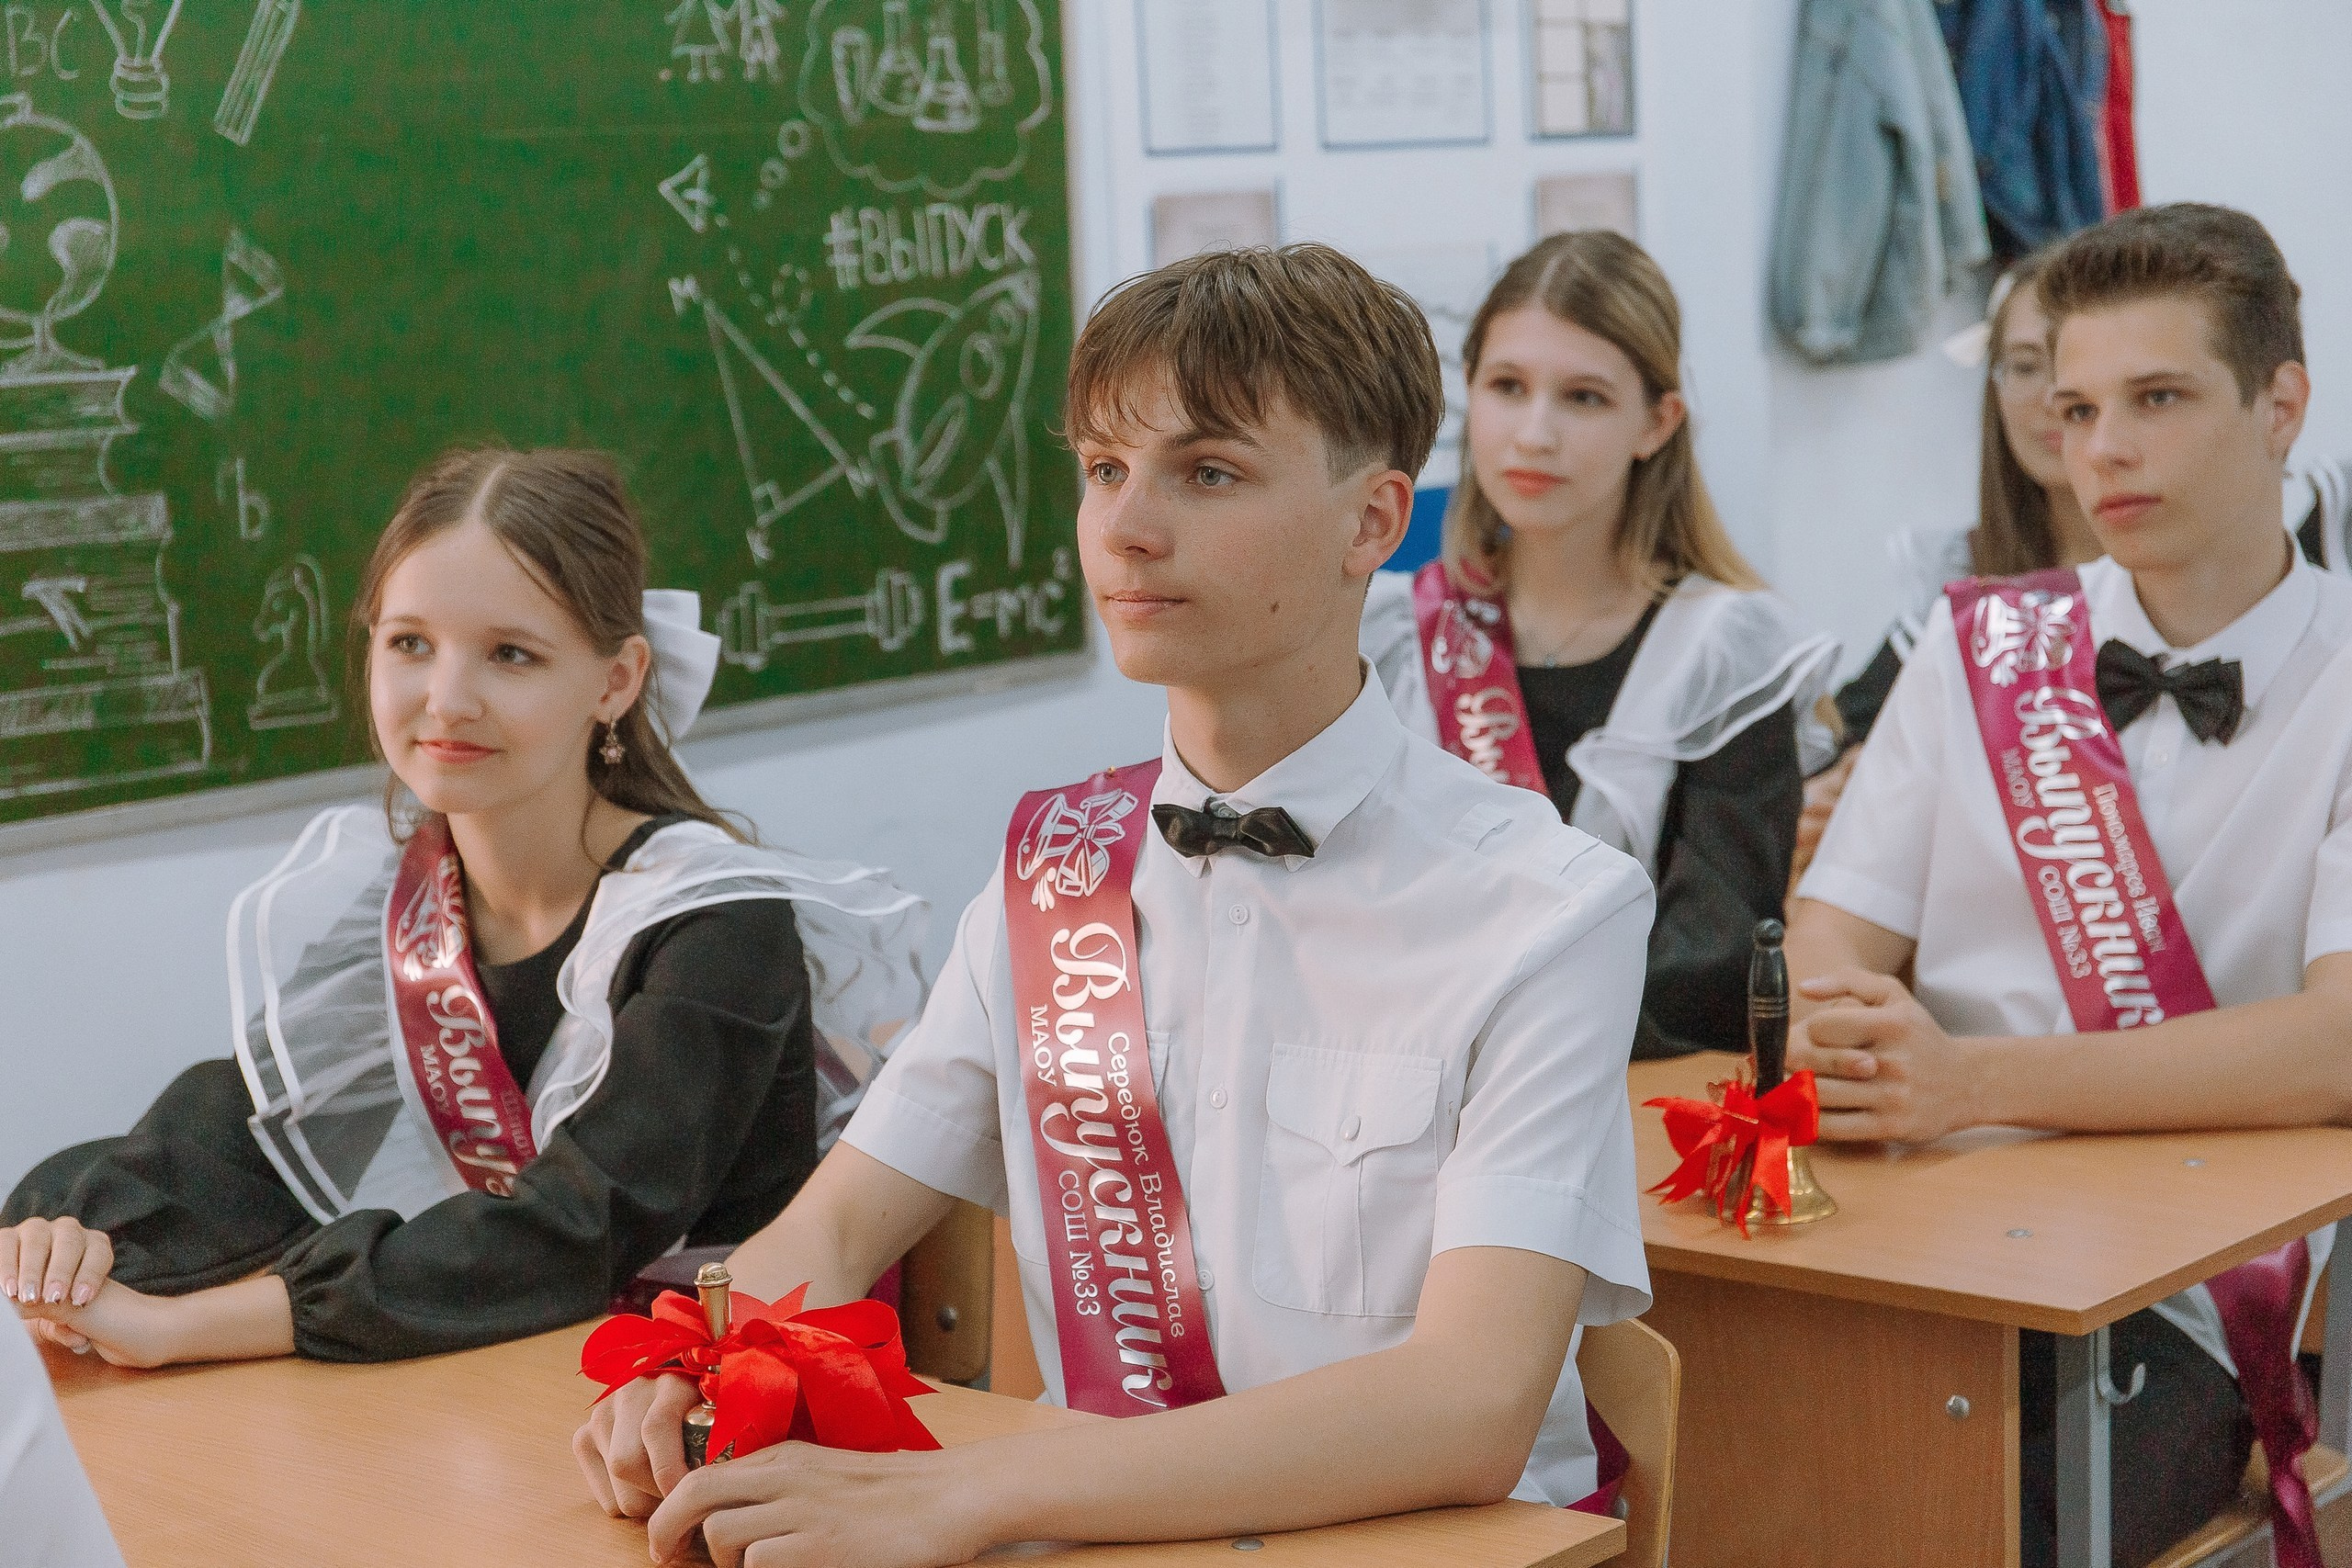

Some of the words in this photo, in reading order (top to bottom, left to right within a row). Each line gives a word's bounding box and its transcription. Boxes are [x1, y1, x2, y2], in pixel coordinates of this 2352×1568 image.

[823, 202, 1036, 291] #ВЫПУСК
[2038, 864, 2075, 924] СОШ
[2058, 924, 2093, 979] №33
[1029, 1004, 1057, 1088] МАОУ
[1040, 921, 1173, 1407] Выпускник
[1057, 1169, 1091, 1243] СОШ
[1106, 1031, 1149, 1167] Середюк
[1138, 1171, 1185, 1339] Владислав
[1069, 1249, 1102, 1317] №33
